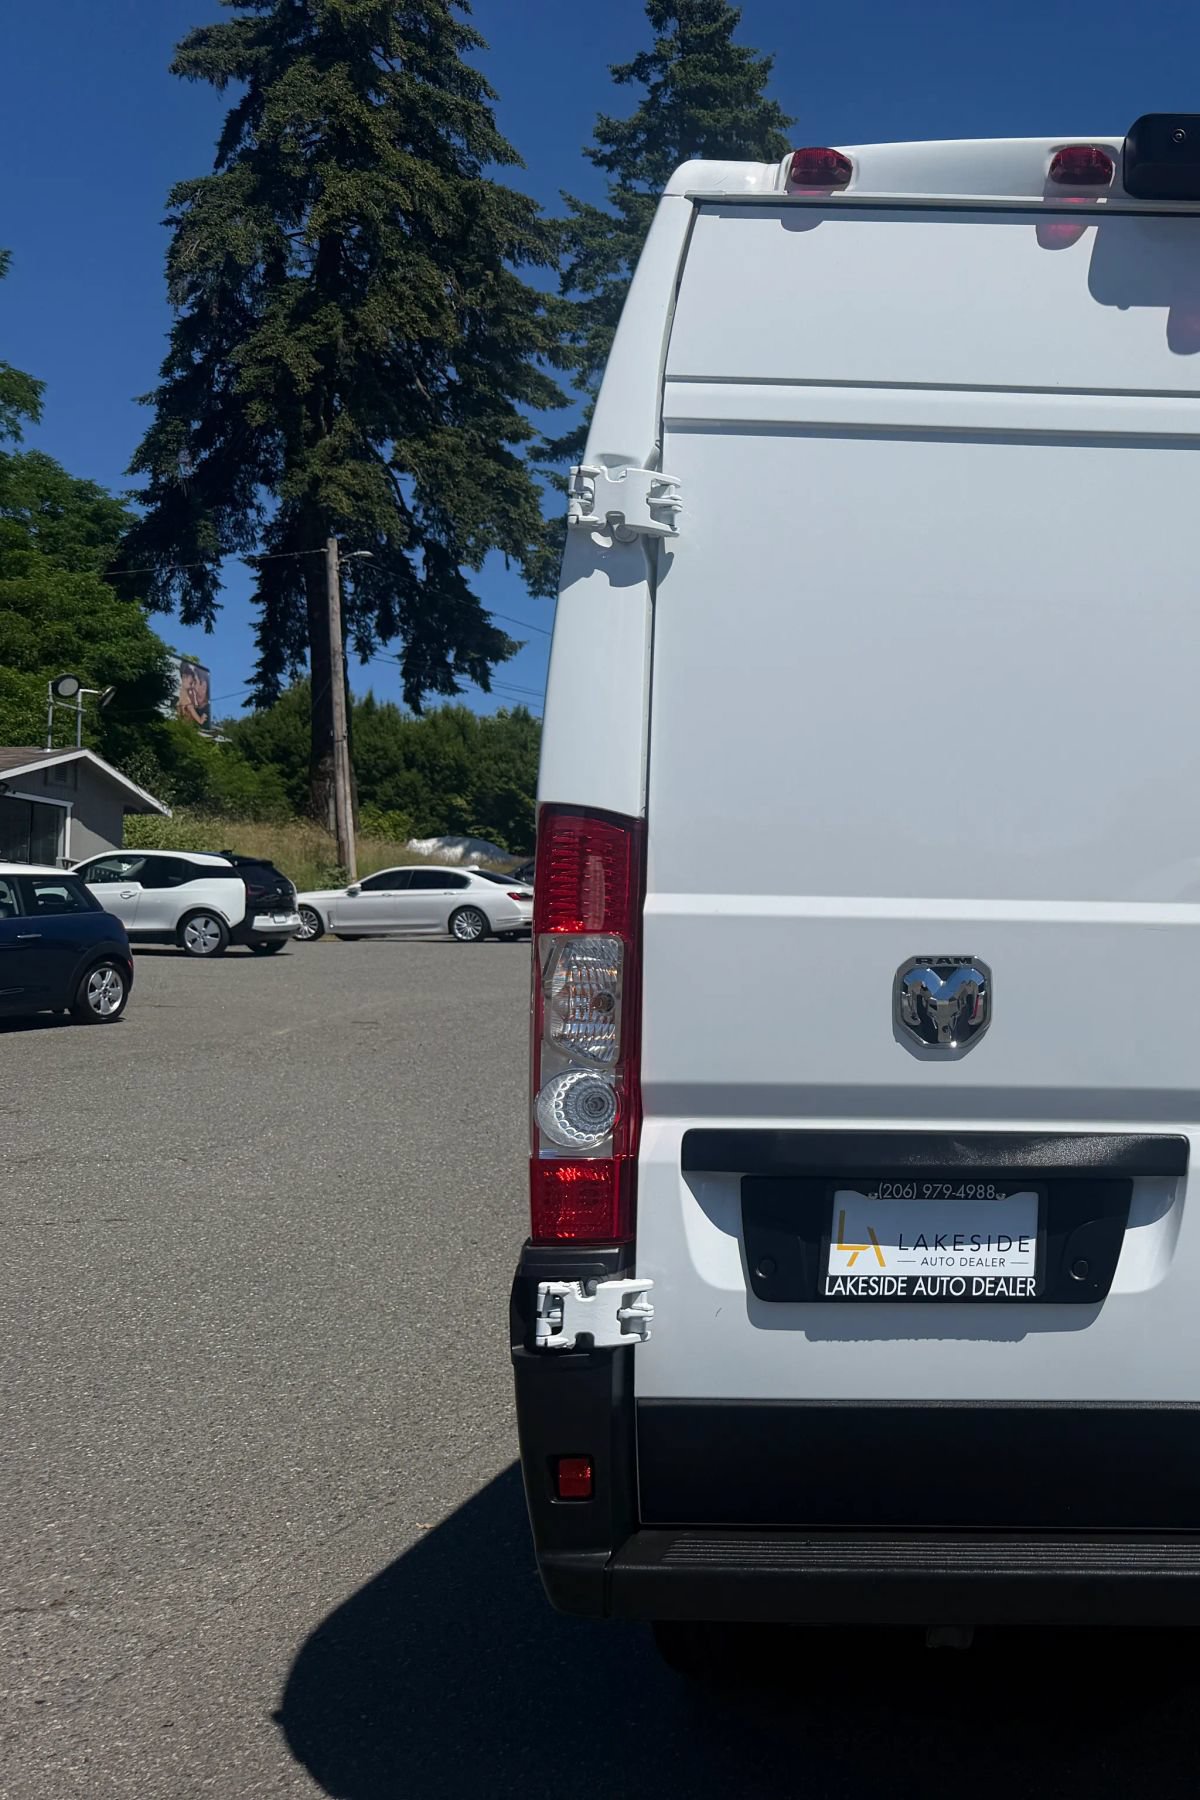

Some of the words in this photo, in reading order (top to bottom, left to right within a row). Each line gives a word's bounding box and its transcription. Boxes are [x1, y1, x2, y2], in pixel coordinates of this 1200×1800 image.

[915, 957, 972, 965] RAM
[878, 1182, 917, 1199] (206)
[922, 1184, 996, 1200] 979-4988
[898, 1233, 1030, 1253] LAKESIDE
[920, 1256, 955, 1267] AUTO
[959, 1257, 1006, 1267] DEALER
[825, 1276, 908, 1296] LAKESIDE
[912, 1276, 967, 1297] AUTO
[972, 1276, 1036, 1297] DEALER
